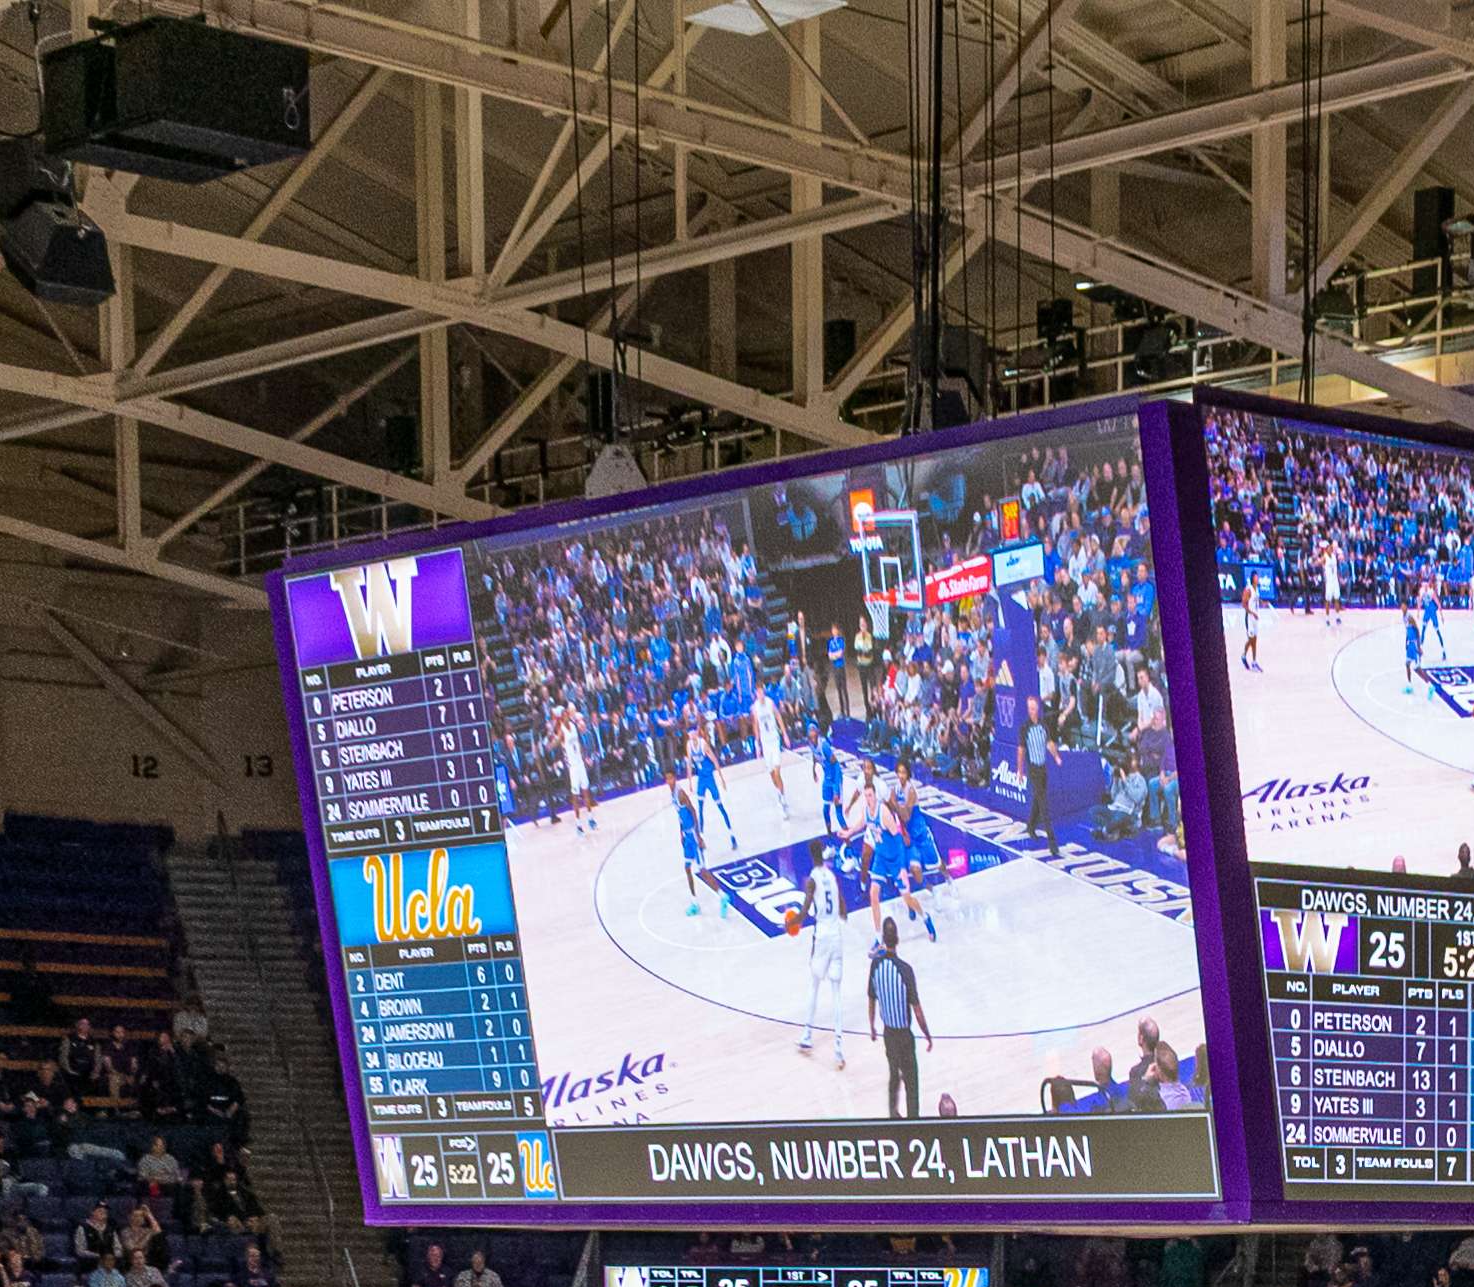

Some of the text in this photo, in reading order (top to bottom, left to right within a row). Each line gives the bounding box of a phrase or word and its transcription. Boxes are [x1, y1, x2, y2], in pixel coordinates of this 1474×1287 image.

[132, 754, 158, 778] 12
[243, 755, 273, 778] 13
[1302, 889, 1371, 916] DAWGS,
[1378, 896, 1449, 920] NUMBER
[1369, 932, 1405, 968] 25
[1314, 1012, 1392, 1032] PETERSON
[1314, 1039, 1365, 1058] DIALLO
[1314, 1069, 1396, 1088] STEINBACH
[1314, 1098, 1360, 1115] YATES
[1286, 1124, 1402, 1146] 24 SOMMERVILLE
[412, 1153, 515, 1186] 25 5:22 25
[648, 1135, 1091, 1185] DAWGS, NUMBER 24, LATHAN
